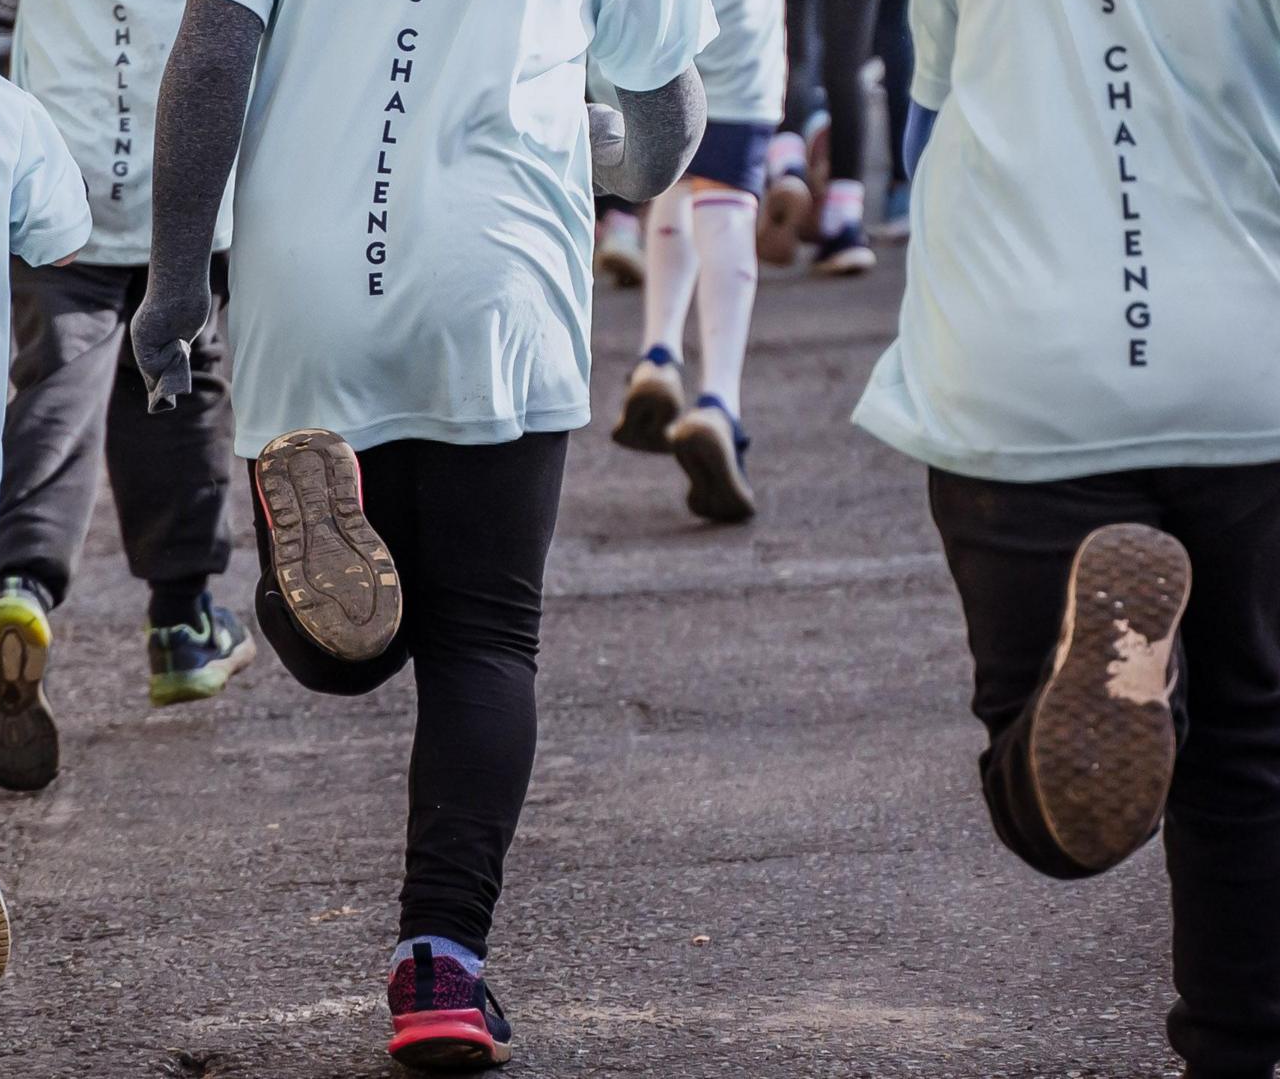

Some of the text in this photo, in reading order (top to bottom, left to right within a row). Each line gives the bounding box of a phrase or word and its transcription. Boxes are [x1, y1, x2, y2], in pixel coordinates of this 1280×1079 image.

[109, 3, 133, 203] CHALLENGE
[365, 27, 419, 298] CHALLENGE
[1102, 44, 1152, 369] CHALLENGE
